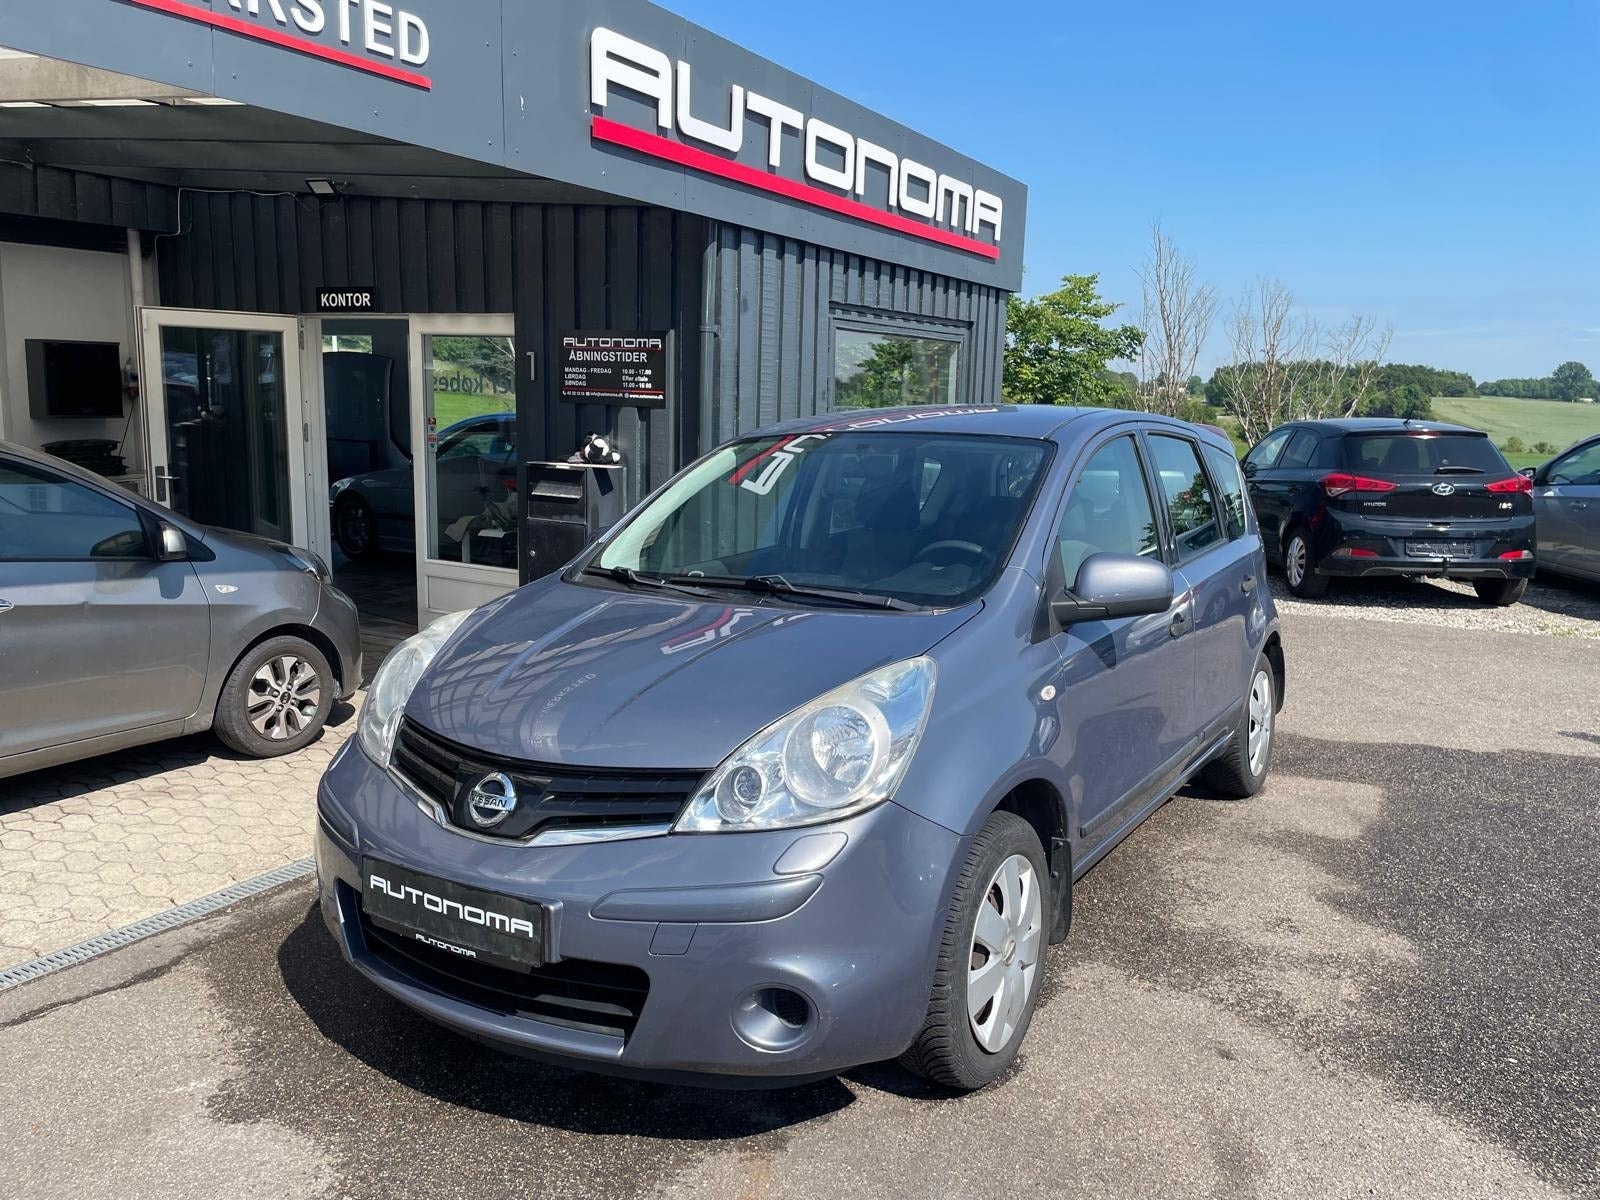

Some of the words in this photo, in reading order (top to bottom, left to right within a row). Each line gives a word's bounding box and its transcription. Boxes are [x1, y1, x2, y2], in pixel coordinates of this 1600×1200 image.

[591, 26, 1003, 241] AUTONOMA
[320, 292, 372, 307] KONTOR
[563, 337, 662, 349] AUTONOMA
[569, 350, 648, 362] ÅBNINGSTIDER
[471, 790, 508, 809] NISSAN
[370, 874, 534, 938] AUTONOMA
[415, 933, 477, 959] AUTONOMA
